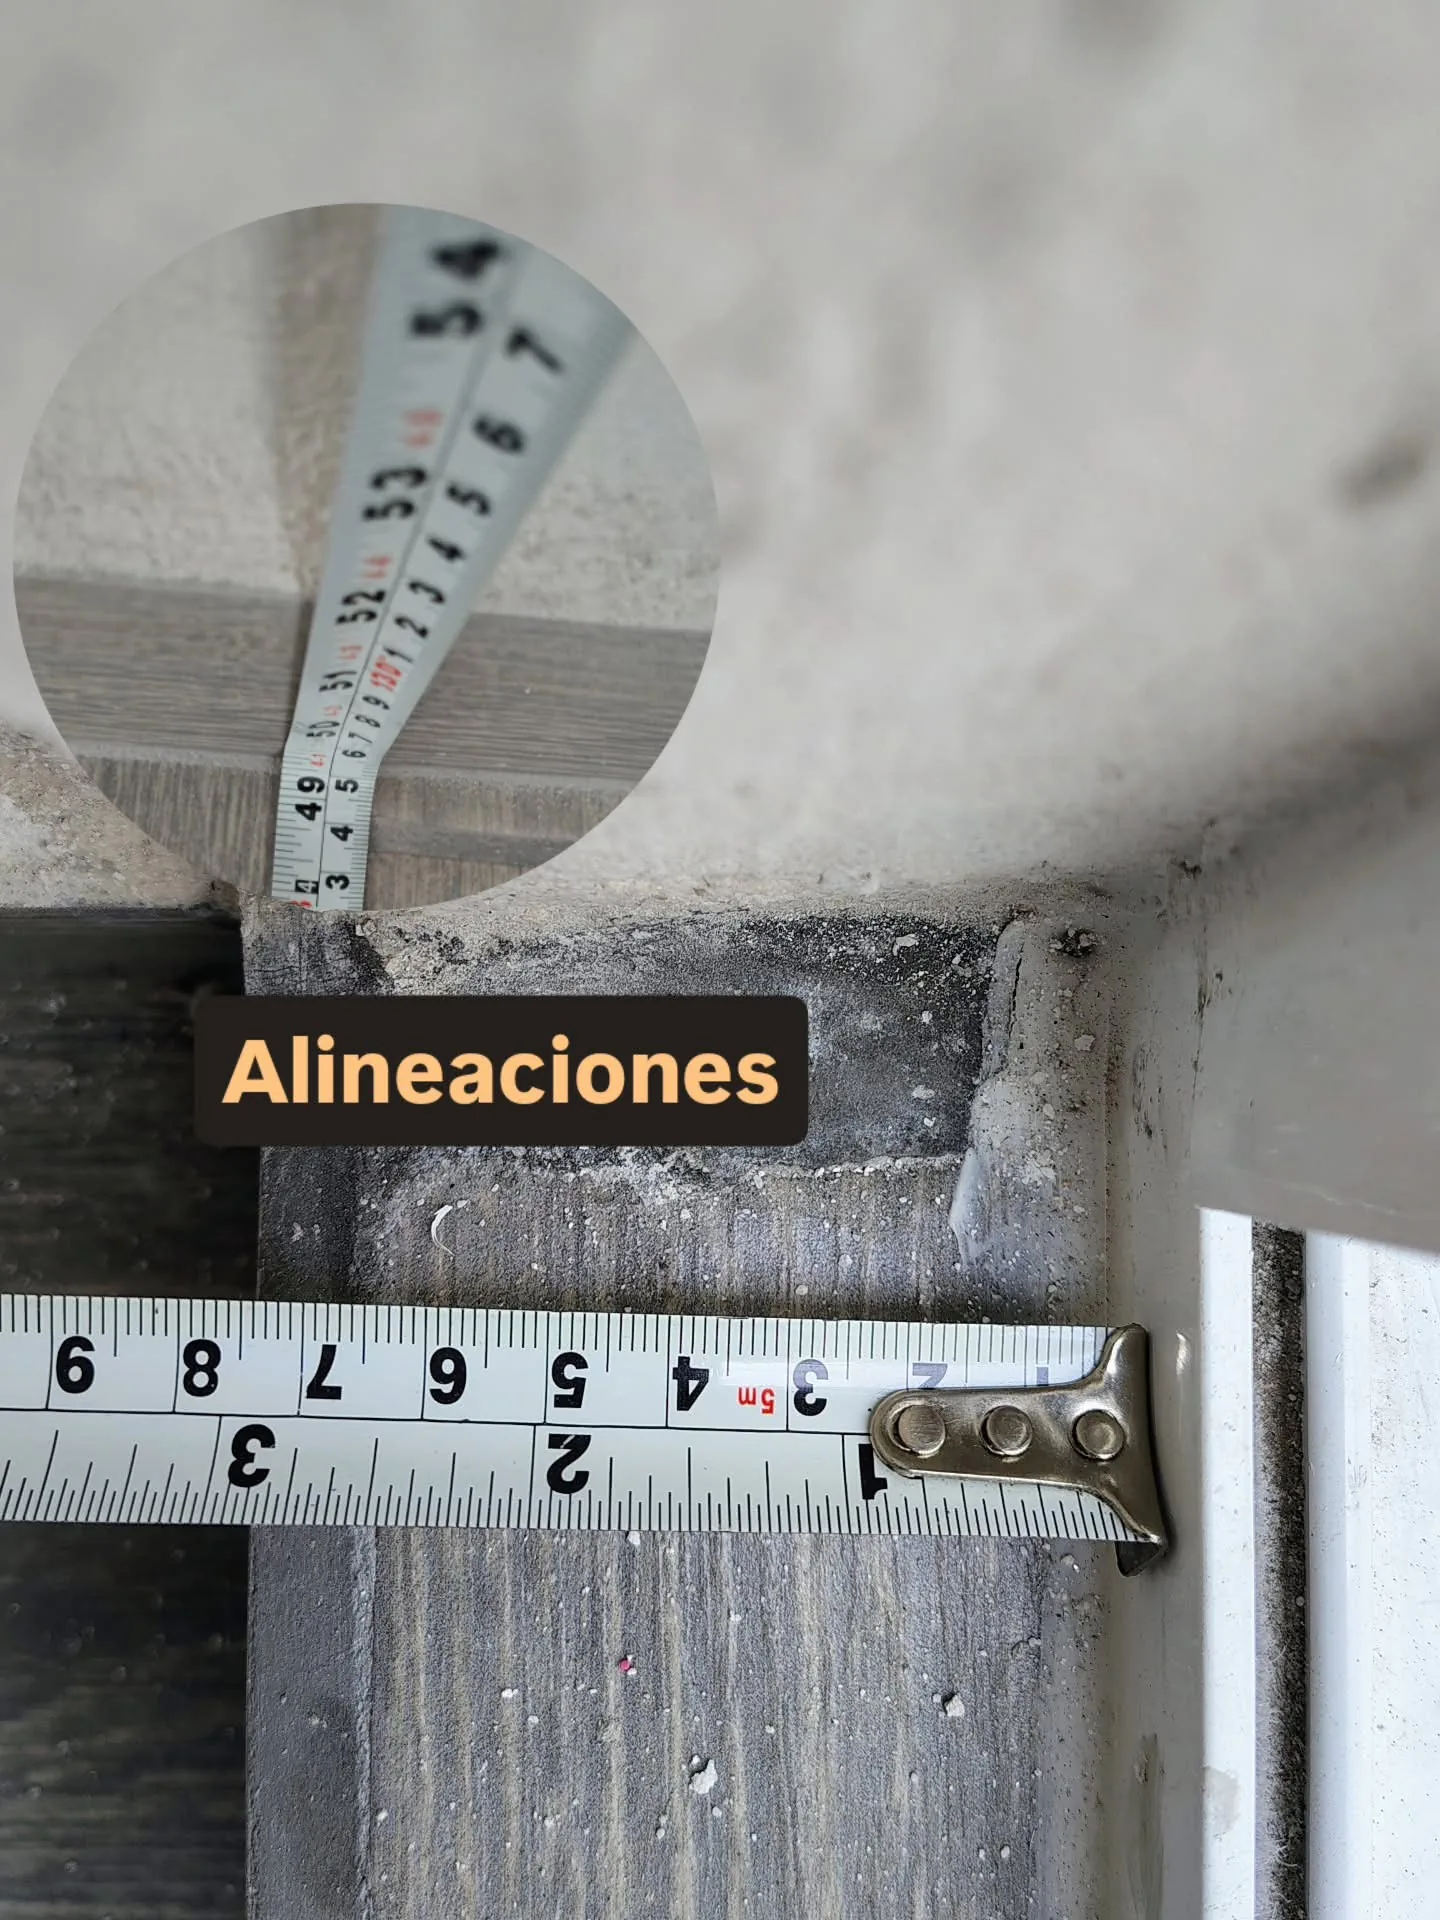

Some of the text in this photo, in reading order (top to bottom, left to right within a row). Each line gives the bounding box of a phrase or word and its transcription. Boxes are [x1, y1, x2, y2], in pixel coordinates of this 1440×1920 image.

[506, 323, 563, 373] 7
[472, 412, 526, 455] 6
[362, 465, 427, 521] 53
[446, 482, 491, 517] 5
[426, 536, 466, 563] 4
[408, 579, 446, 604] 3
[336, 589, 387, 625] 52
[395, 615, 430, 638] 2
[383, 646, 413, 664] 1
[319, 671, 357, 692] 51
[362, 695, 390, 710] 9
[306, 720, 340, 738] 50
[355, 714, 380, 728] 8
[348, 731, 373, 744] 7
[342, 749, 367, 758] 6
[335, 778, 359, 794] 5
[295, 776, 325, 821] 49
[330, 825, 354, 842] 4
[325, 874, 350, 890] 3
[56, 1335, 829, 1416] 9 8 7 6 5 4 3
[737, 1386, 775, 1415] 5m
[227, 1424, 888, 1500] 3 2 1
